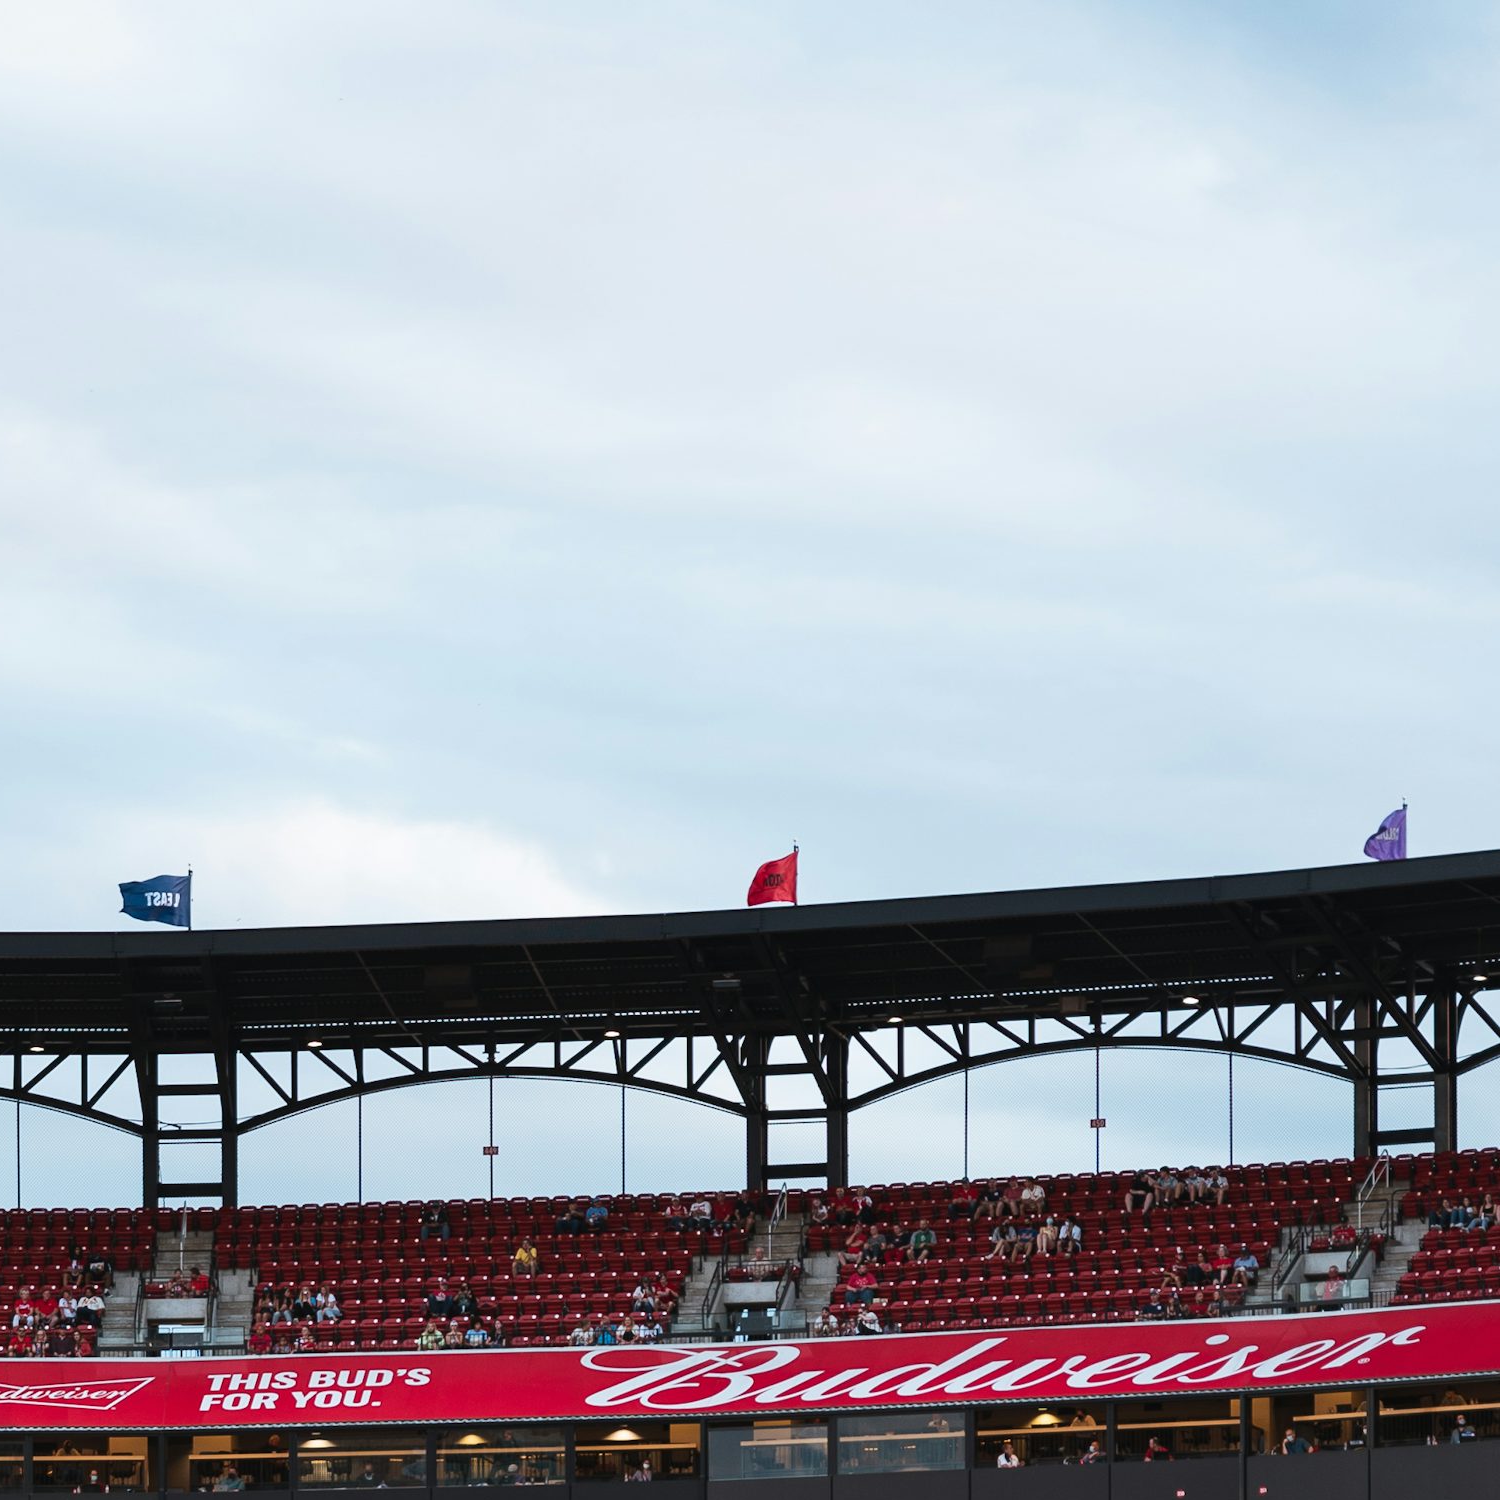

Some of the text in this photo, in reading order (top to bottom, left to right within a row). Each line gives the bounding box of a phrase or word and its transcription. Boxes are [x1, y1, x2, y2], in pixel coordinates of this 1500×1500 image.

[207, 1368, 431, 1391] THIS BUD’S
[581, 1326, 1425, 1410] Budweiser
[199, 1389, 381, 1411] FOR YOU.
